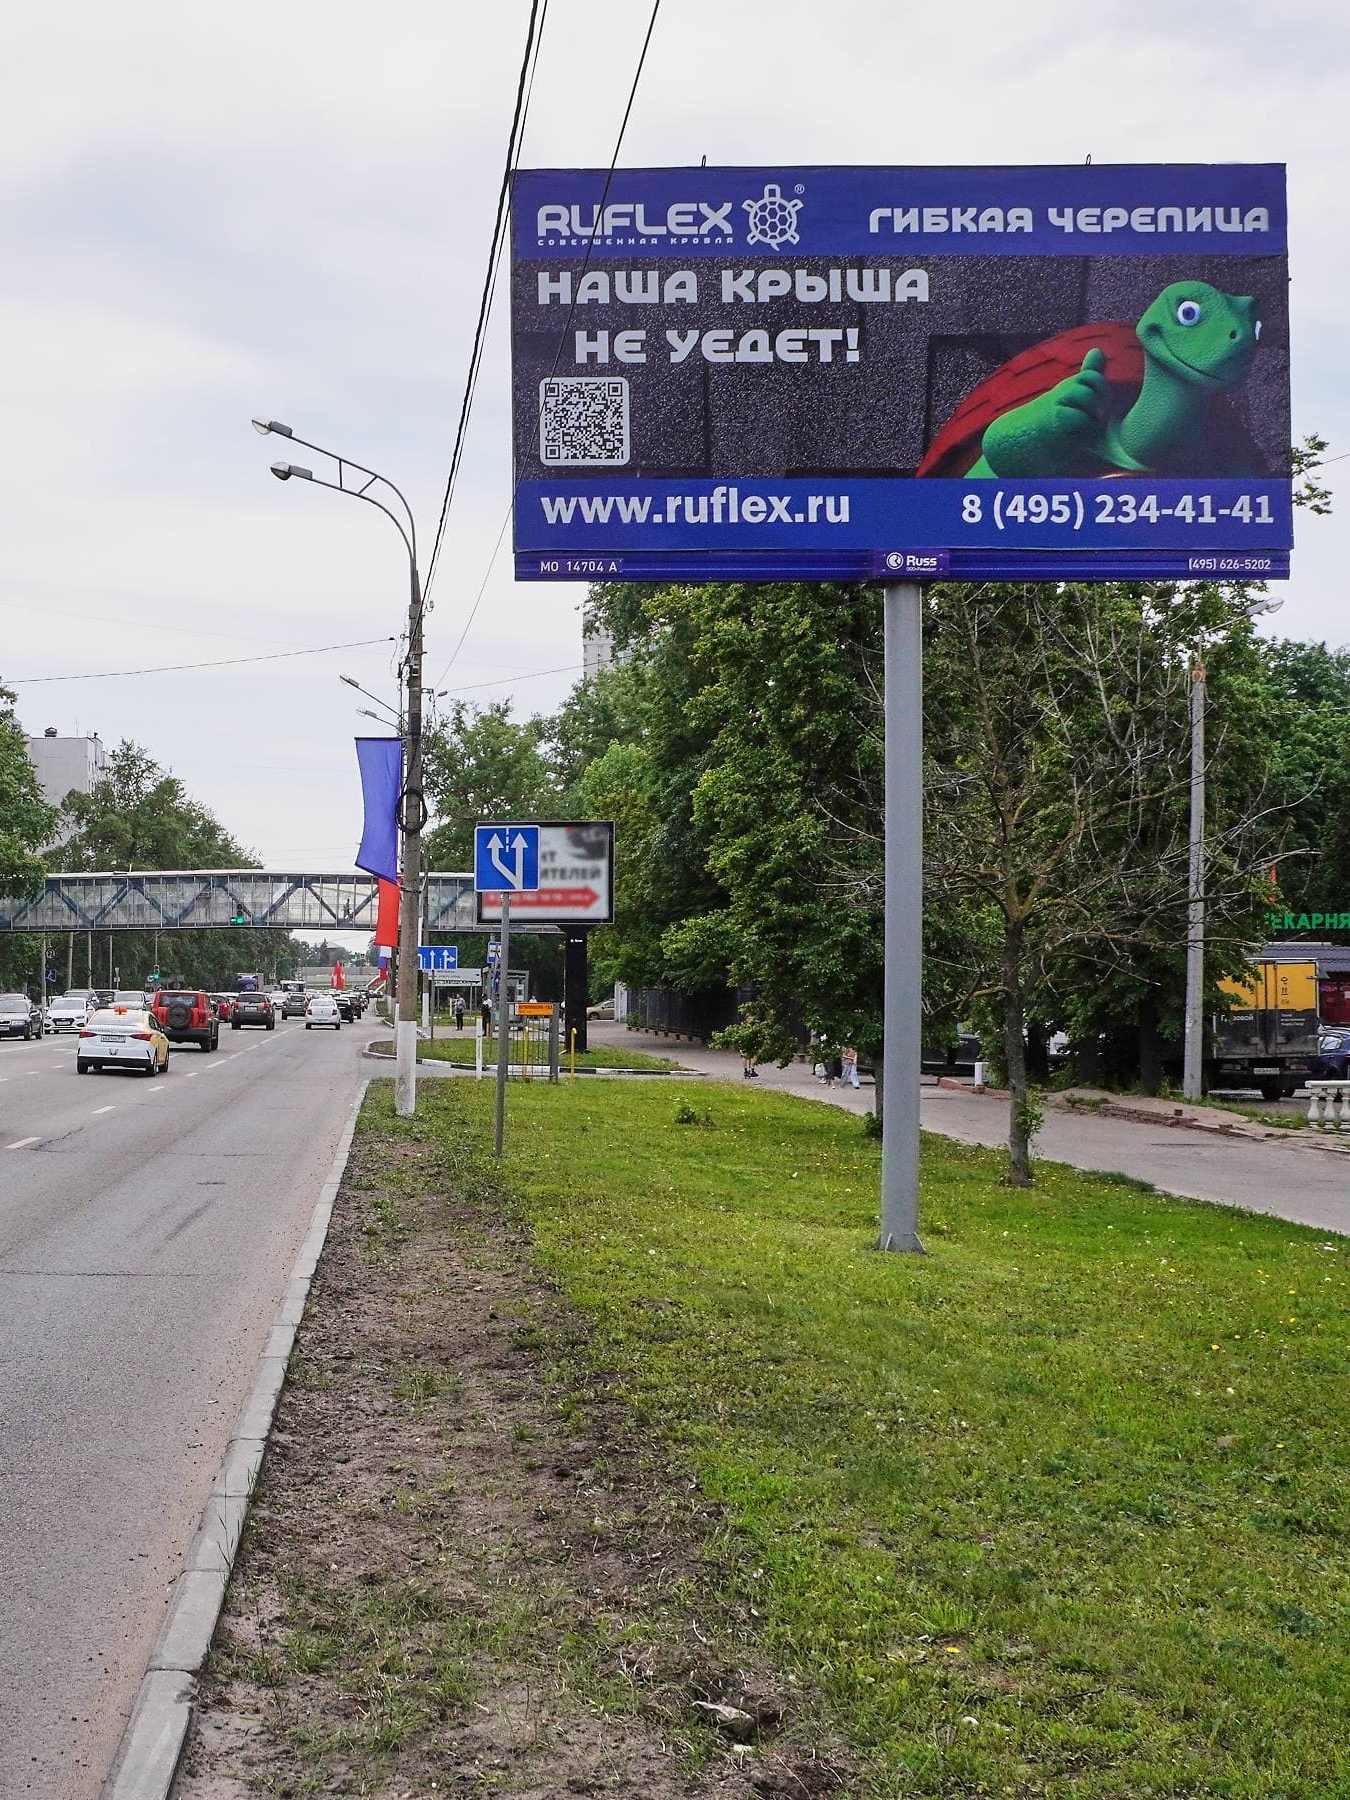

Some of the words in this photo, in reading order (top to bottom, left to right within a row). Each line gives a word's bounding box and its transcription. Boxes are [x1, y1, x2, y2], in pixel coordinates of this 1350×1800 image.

[537, 202, 733, 237] RUFLEX
[869, 207, 1033, 233] ГИБКАЯ
[1047, 207, 1269, 233] ЧЕРЕПИЦА
[537, 237, 658, 246] СОВЕРШЕННАЯ
[670, 236, 734, 246] КРОВЛЯ
[537, 270, 698, 305] НАША
[721, 268, 930, 303] КРЫША
[575, 330, 647, 364] НЕ
[665, 327, 860, 364] УЕДЕТ!
[540, 487, 850, 524] www.ruflex.ru
[961, 494, 983, 524] 8
[993, 490, 1084, 530] (495)
[1094, 493, 1275, 524] 234-41-41
[540, 560, 559, 572] МО
[566, 560, 605, 572] 14704
[608, 561, 618, 572] А
[906, 555, 938, 567] Russ
[1188, 557, 1217, 571] (495)
[1219, 558, 1271, 570] 626-5202
[1265, 912, 1350, 930] ЕКАРНЯ
